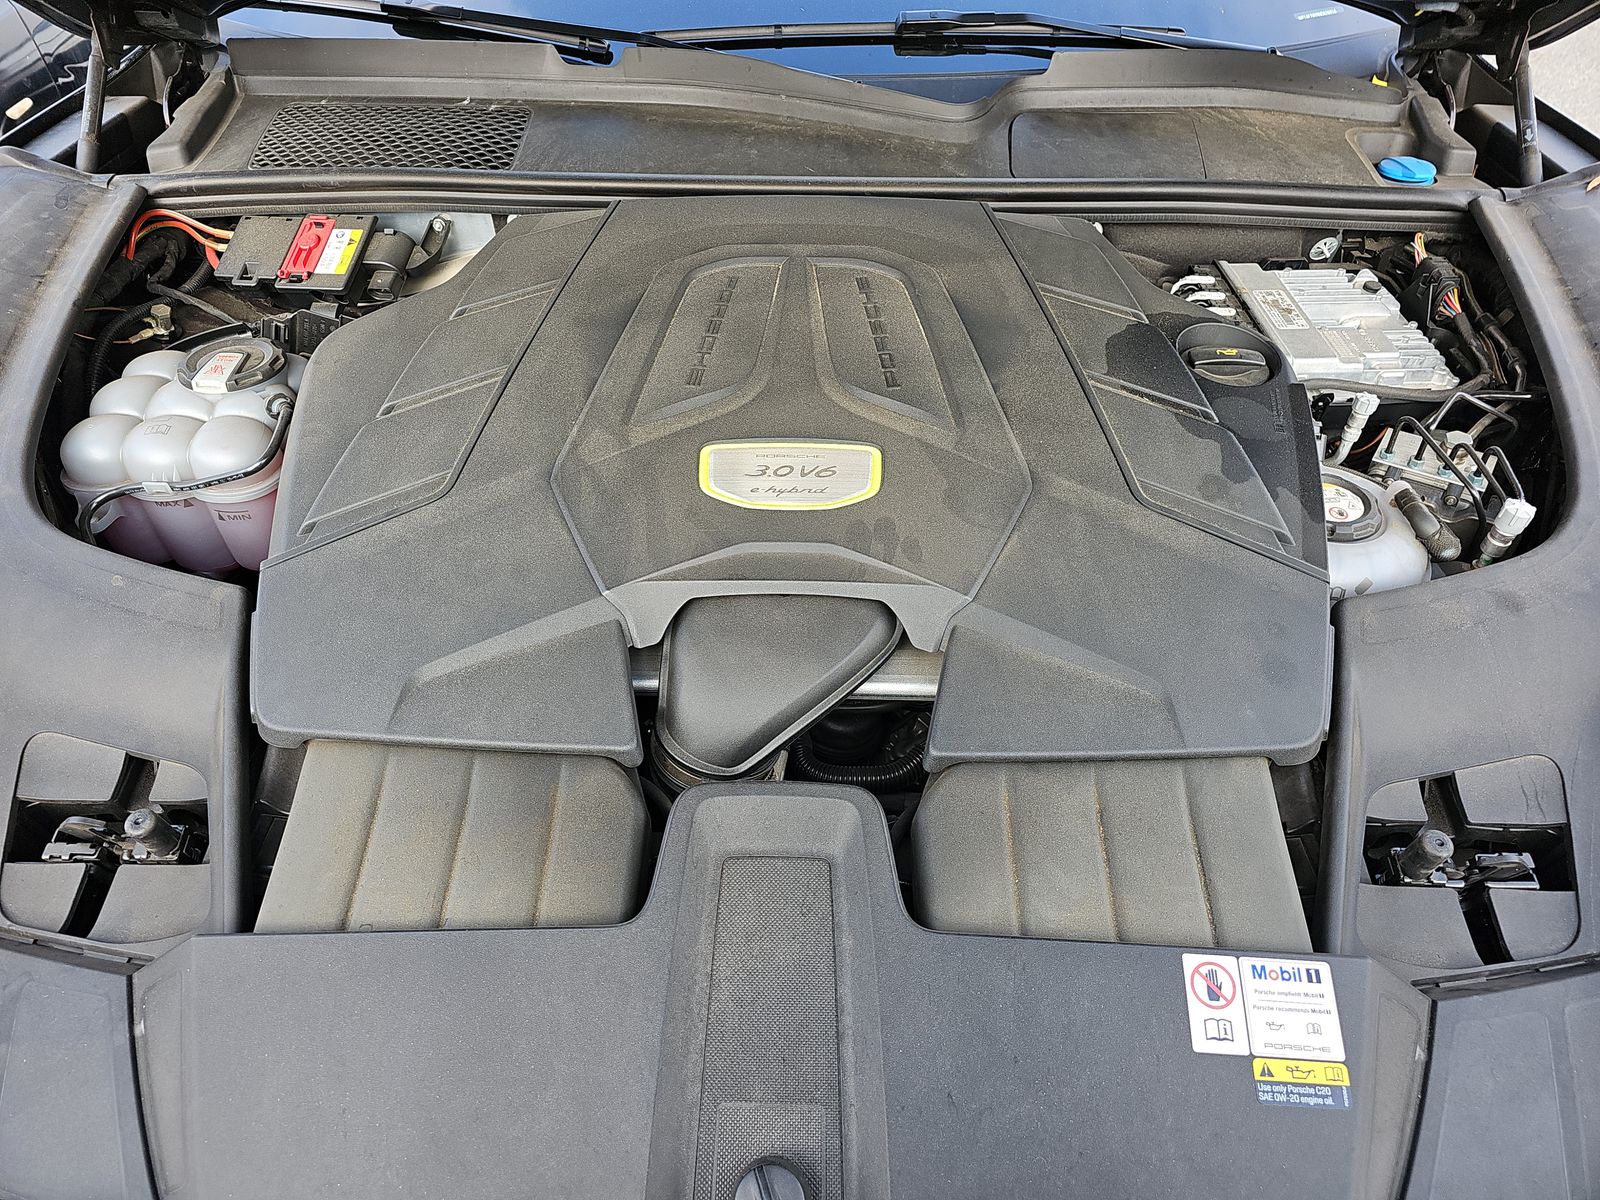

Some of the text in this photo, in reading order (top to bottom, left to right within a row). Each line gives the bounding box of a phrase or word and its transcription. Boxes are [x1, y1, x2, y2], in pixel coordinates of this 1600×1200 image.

[686, 275, 739, 387] PORSCHE
[855, 275, 900, 389] PORSCHE
[744, 464, 837, 478] 3.0 V6
[154, 500, 181, 508] MAX
[226, 513, 252, 521] MIN
[1251, 964, 1303, 983] Mobil
[1264, 1042, 1331, 1053] PORSCHE
[1257, 1082, 1332, 1096] Use only Porsche C20
[1258, 1092, 1275, 1102] SAE
[1274, 1093, 1300, 1103] 0W-20
[1300, 1095, 1324, 1106] engine
